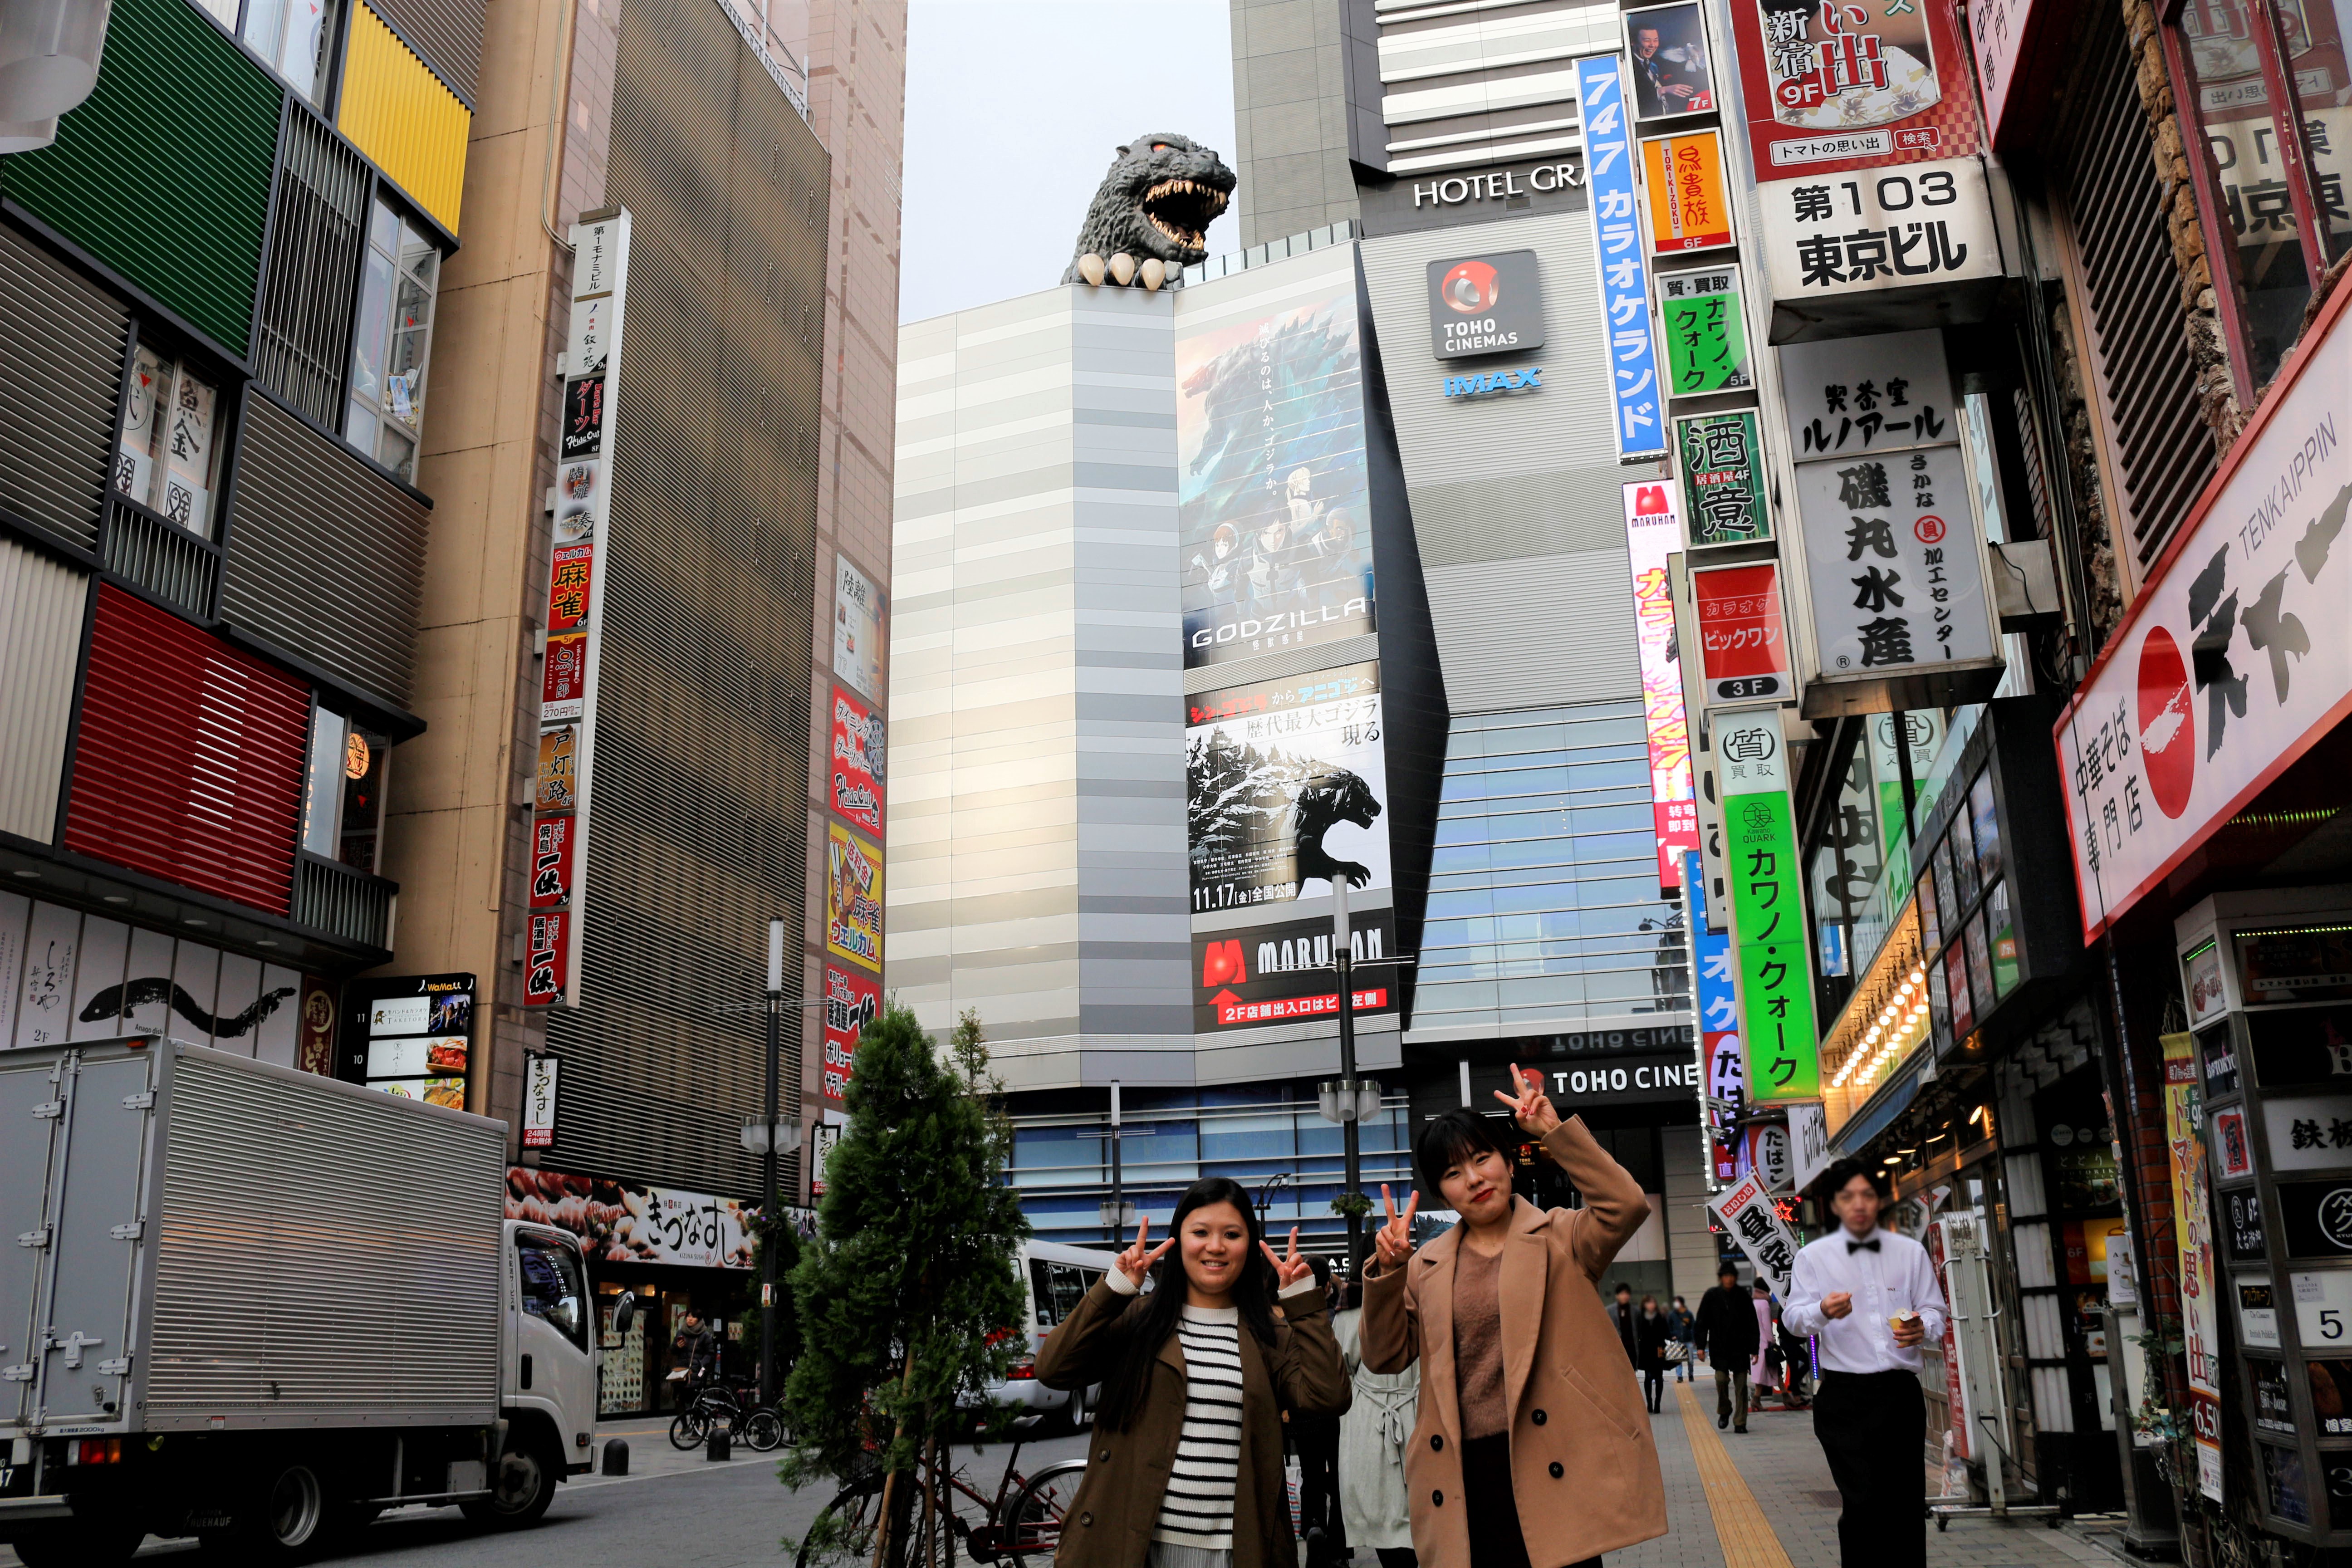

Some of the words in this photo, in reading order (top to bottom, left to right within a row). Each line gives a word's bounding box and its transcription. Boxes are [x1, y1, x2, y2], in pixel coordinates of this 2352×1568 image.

[1769, 7, 1816, 78] 新宿
[1689, 97, 1708, 109] 7F
[1783, 82, 1818, 106] 9F
[1783, 137, 1881, 158] トマトの思い出
[1902, 132, 1931, 145] 検索
[1414, 171, 1524, 207] HOTEL
[1663, 149, 1679, 224] TORIKIZOKU
[1678, 145, 1710, 226] 鳥貴族
[1792, 171, 1956, 222] 第103
[589, 225, 605, 290] 第1モナミビル
[1585, 72, 1653, 439] 747カラオケランド
[1683, 237, 1702, 249] 6F
[1796, 220, 1967, 287] 東京ビル
[1667, 276, 1730, 296] 質・買取
[1444, 318, 1495, 337] TOHO
[1445, 332, 1518, 352] CINEMAS
[1676, 310, 1705, 390] クォーク
[598, 362, 606, 370] 9F
[1730, 373, 1749, 386] 5F
[593, 383, 603, 407] Darts
[1444, 367, 1542, 397] IMAX
[1825, 377, 1910, 414] 喫茶室
[574, 380, 594, 433] ダーツ
[592, 408, 601, 424] Bar
[1259, 322, 1277, 497] 滅びるのは、人か、ゴジラか。
[566, 435, 587, 449] Hide
[586, 431, 600, 441] Out
[1803, 405, 1945, 453] ルノアール
[1695, 471, 1735, 485] 居酒屋
[1735, 470, 1750, 480] 4F
[1910, 454, 1935, 508] さかな
[2237, 412, 2338, 562] TENKAIPPIN
[1632, 514, 1676, 528] MARUHAN
[555, 547, 592, 562] ウェルカム
[1837, 462, 1915, 667] 磯丸水産
[552, 562, 588, 620] 麻雀
[1923, 548, 1953, 660] 加工センター
[577, 617, 588, 627] 6F
[1192, 596, 1366, 649] GODZILLA
[1706, 598, 1770, 616] カラオケ
[1252, 630, 1305, 651] 怪獣惑星
[1705, 627, 1779, 651] ビックワン
[837, 700, 870, 739] ダイニング
[1247, 698, 1377, 740] 歴代最大ゴジラ
[1342, 721, 1380, 747] 現る
[837, 738, 870, 772] ダーツバー
[2075, 697, 2132, 799] 中華そば
[1731, 764, 1774, 779] 買取
[836, 773, 857, 807] Hide
[857, 784, 872, 805] Out
[1668, 805, 1695, 818] 转弯
[1668, 819, 1695, 833] 即到
[2085, 773, 2142, 875] 専門店
[538, 824, 552, 853] 焼鳥
[1743, 833, 1776, 843] QUARK
[534, 853, 561, 897] 一休
[847, 841, 869, 885] 低料金
[853, 893, 881, 936] 麻雀
[532, 917, 546, 951] 居酒屋
[831, 918, 876, 961] ウェルカム
[1257, 928, 1382, 974] MARUAN
[529, 950, 555, 995] 一休
[828, 969, 848, 989] 東京で一番
[357, 1014, 365, 1023] 11
[827, 996, 848, 1034] 居酒屋
[1225, 992, 1377, 1022] 2F店舗出入口はビ左側
[34, 1029, 49, 1042] 2F
[135, 1024, 152, 1033] Anago
[353, 1055, 363, 1064] 10
[825, 1040, 855, 1072] ボリュー
[533, 1060, 551, 1125] きづなすし
[825, 1070, 849, 1099] サラリー
[1553, 1069, 1627, 1094] TOHO
[1765, 1131, 1784, 1183] たばこ
[1724, 1186, 1754, 1216] おいしい
[648, 1192, 737, 1265] きづなすし
[2172, 1086, 2209, 1385] トマトの思い出
[2067, 1247, 2083, 1258] 6F
[2320, 1310, 2342, 1339] 5
